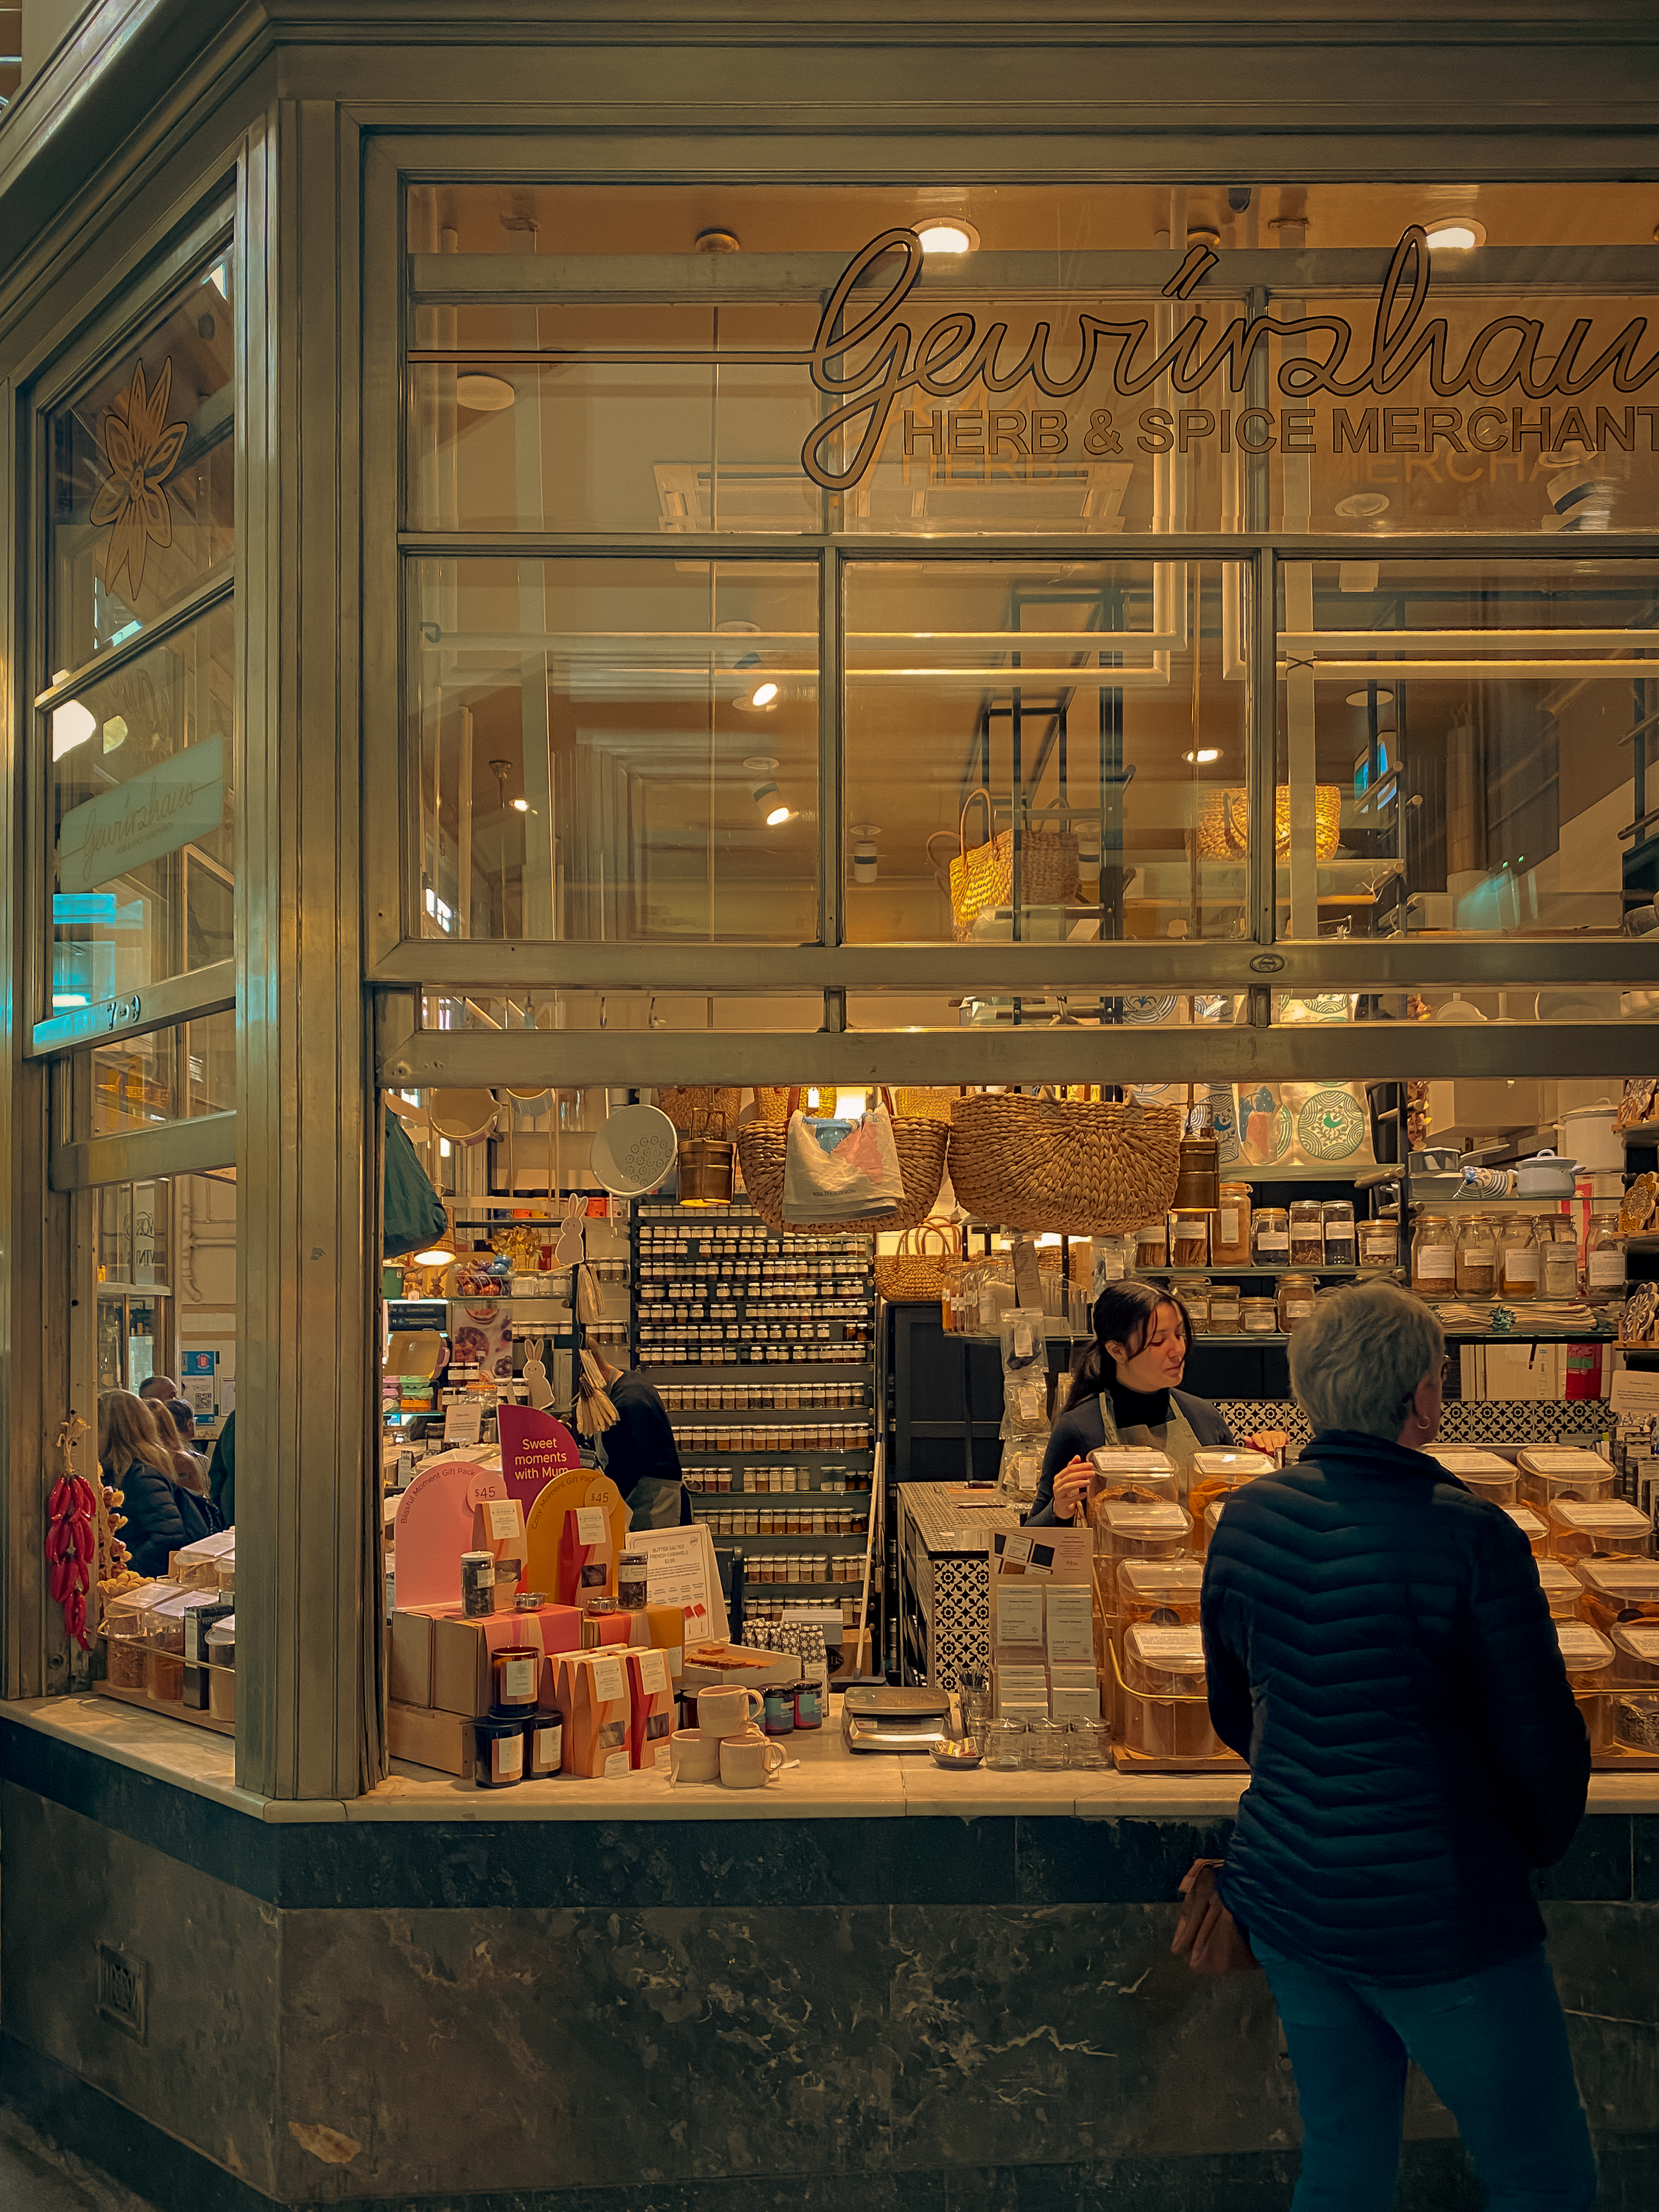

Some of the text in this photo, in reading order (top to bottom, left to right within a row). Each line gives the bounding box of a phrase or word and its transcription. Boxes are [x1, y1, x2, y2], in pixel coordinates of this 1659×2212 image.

[903, 409, 1069, 455] HERB
[1084, 409, 1124, 455] &
[1137, 408, 1317, 455] SPICE
[522, 1437, 557, 1450] Sweet
[515, 1452, 567, 1465] moments
[515, 1466, 568, 1481] with Mum
[400, 1468, 476, 1523] Blissful Moment Gift Pack
[475, 1486, 496, 1499] $45
[591, 1492, 609, 1503] $45
[531, 1508, 543, 1530] Cosy
[539, 1481, 565, 1508] Moment
[566, 1476, 579, 1485] Gift
